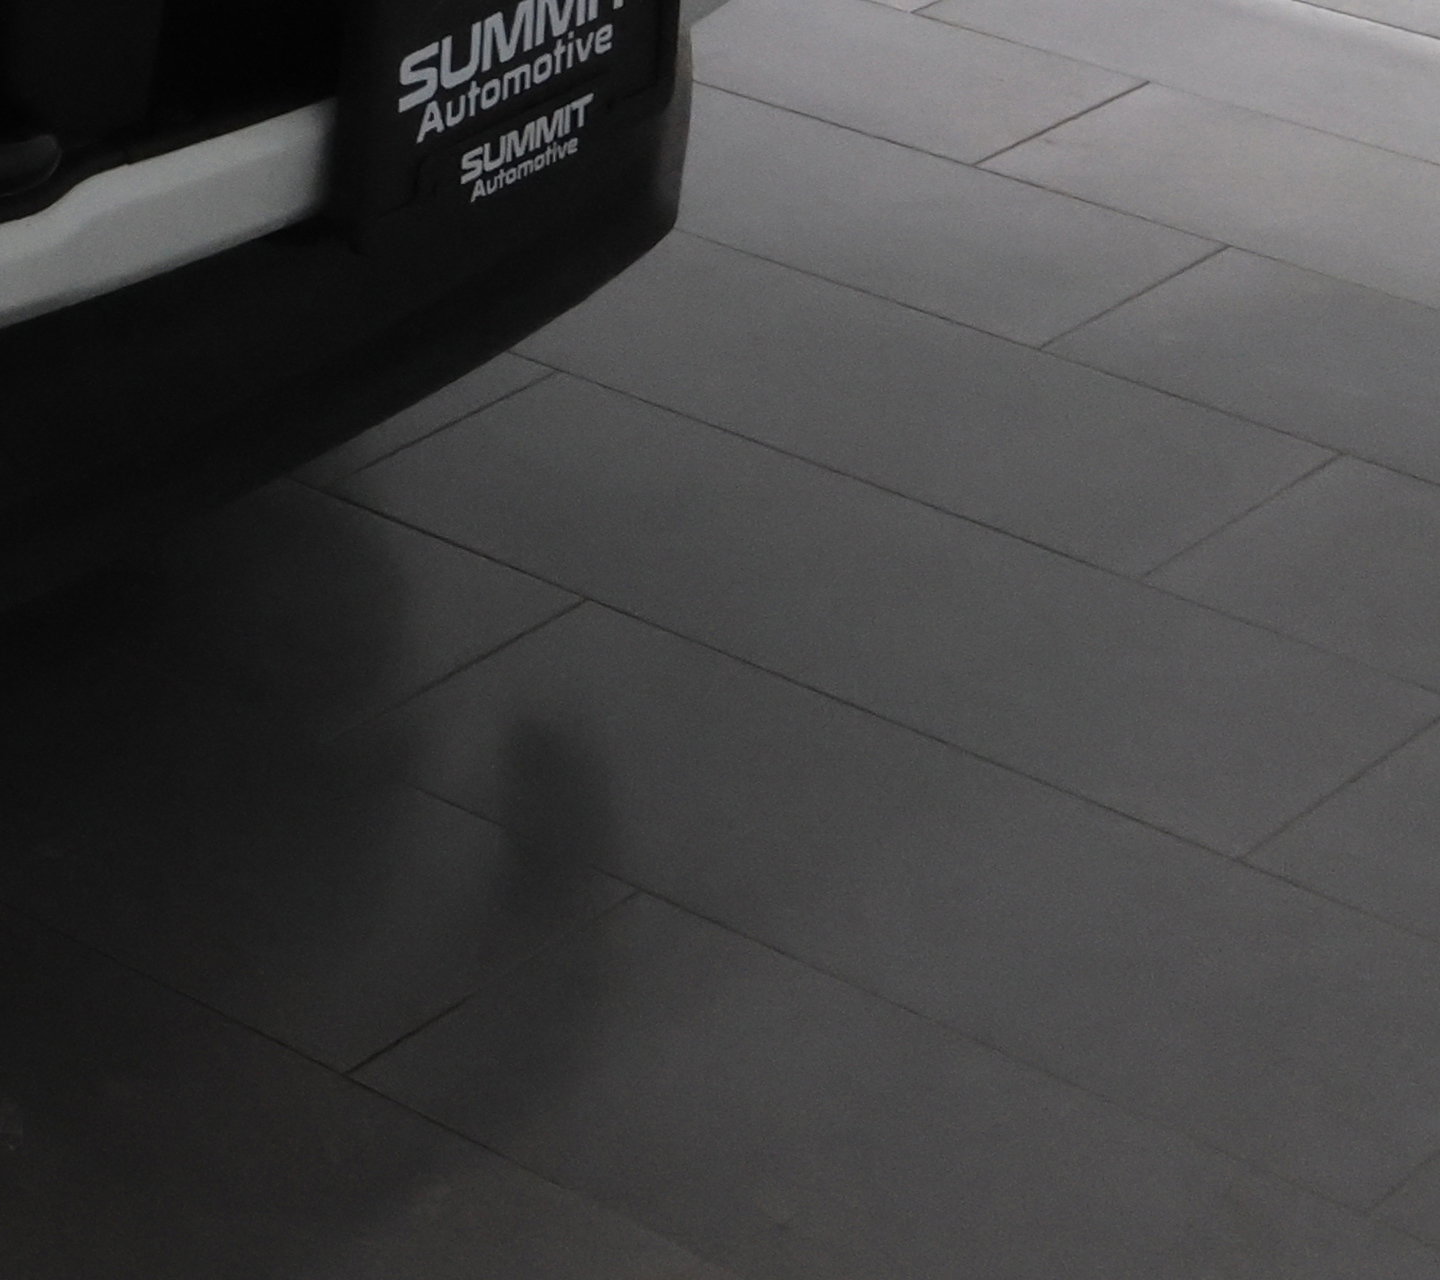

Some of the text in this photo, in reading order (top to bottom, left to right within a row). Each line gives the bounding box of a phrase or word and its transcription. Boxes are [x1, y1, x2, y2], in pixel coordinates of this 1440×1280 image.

[416, 22, 614, 144] Automotive
[460, 92, 595, 185] SUMMIT
[469, 136, 580, 203] Automotive
